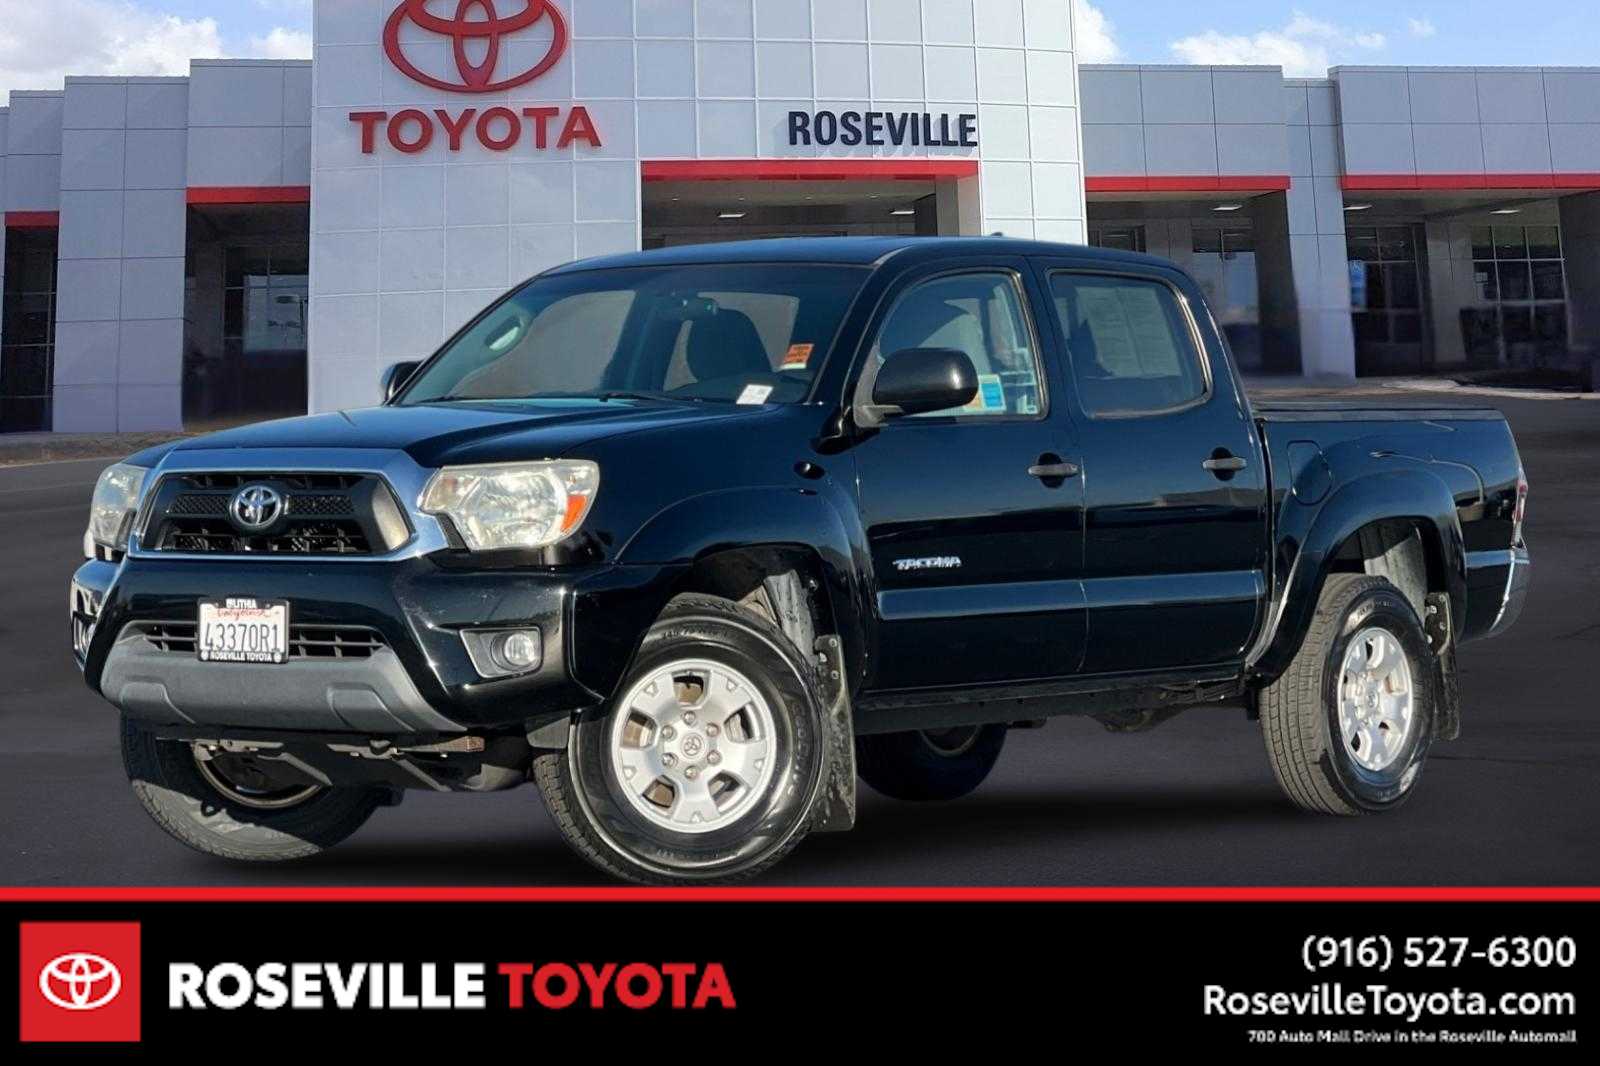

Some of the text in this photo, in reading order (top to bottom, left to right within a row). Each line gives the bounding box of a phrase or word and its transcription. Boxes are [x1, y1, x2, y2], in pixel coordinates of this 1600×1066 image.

[349, 106, 602, 153] TOYOTA
[789, 111, 978, 147] ROSEVILLE
[205, 622, 278, 652] 43370R1
[210, 652, 272, 662] ROSEVILLE TOYOTA
